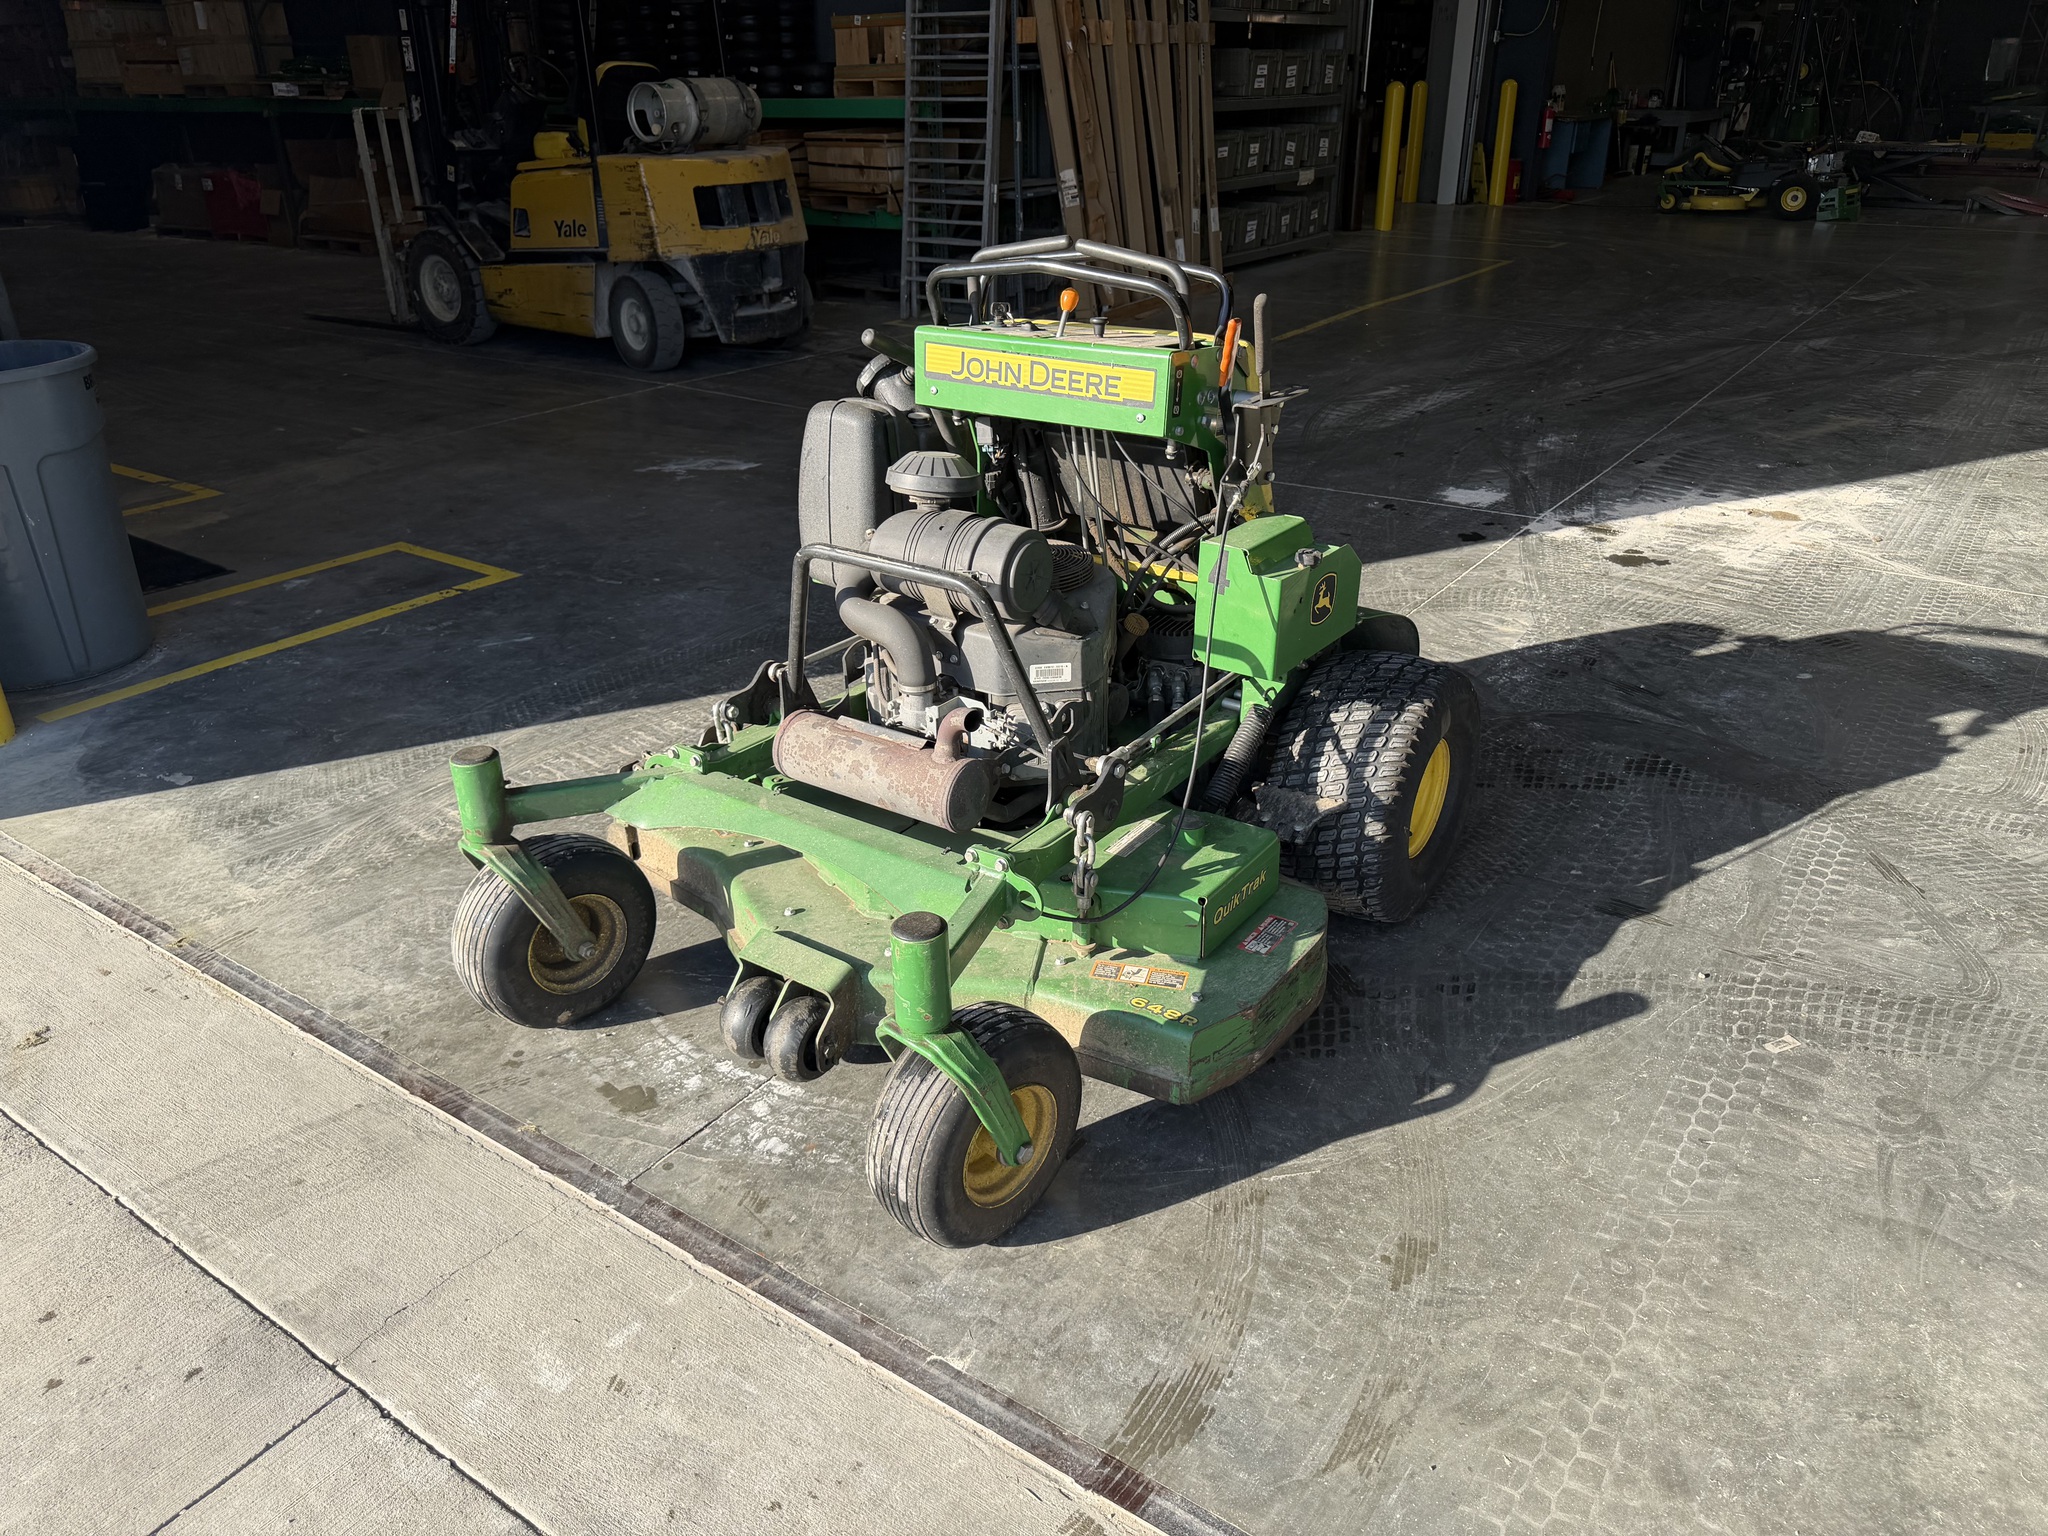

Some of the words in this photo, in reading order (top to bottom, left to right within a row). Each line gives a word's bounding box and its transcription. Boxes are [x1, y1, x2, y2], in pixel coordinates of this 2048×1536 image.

[554, 219, 587, 238] Yale
[752, 228, 781, 247] Yale
[951, 351, 1022, 385] JOHN
[1029, 360, 1122, 398] DEERE
[1130, 997, 1199, 1027] 648R
